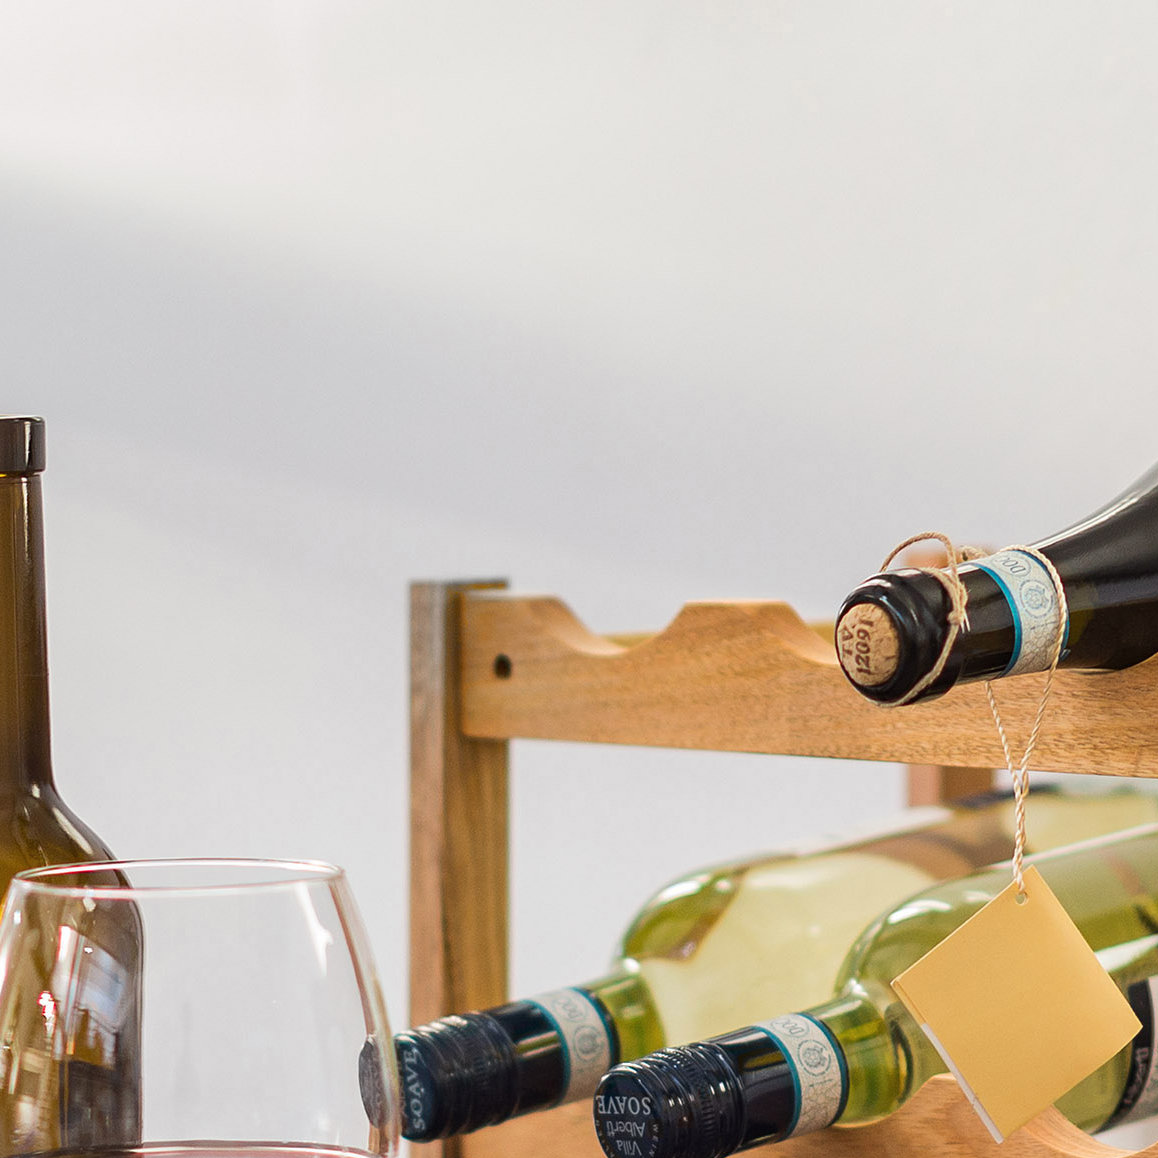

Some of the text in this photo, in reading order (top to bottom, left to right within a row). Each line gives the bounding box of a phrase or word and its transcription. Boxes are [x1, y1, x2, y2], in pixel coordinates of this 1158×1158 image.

[855, 618, 875, 676] 12091
[402, 1048, 426, 1131] SOAVE
[594, 1095, 652, 1116] SOAVE
[606, 1120, 646, 1138] Alberti
[616, 1139, 643, 1156] Villa
